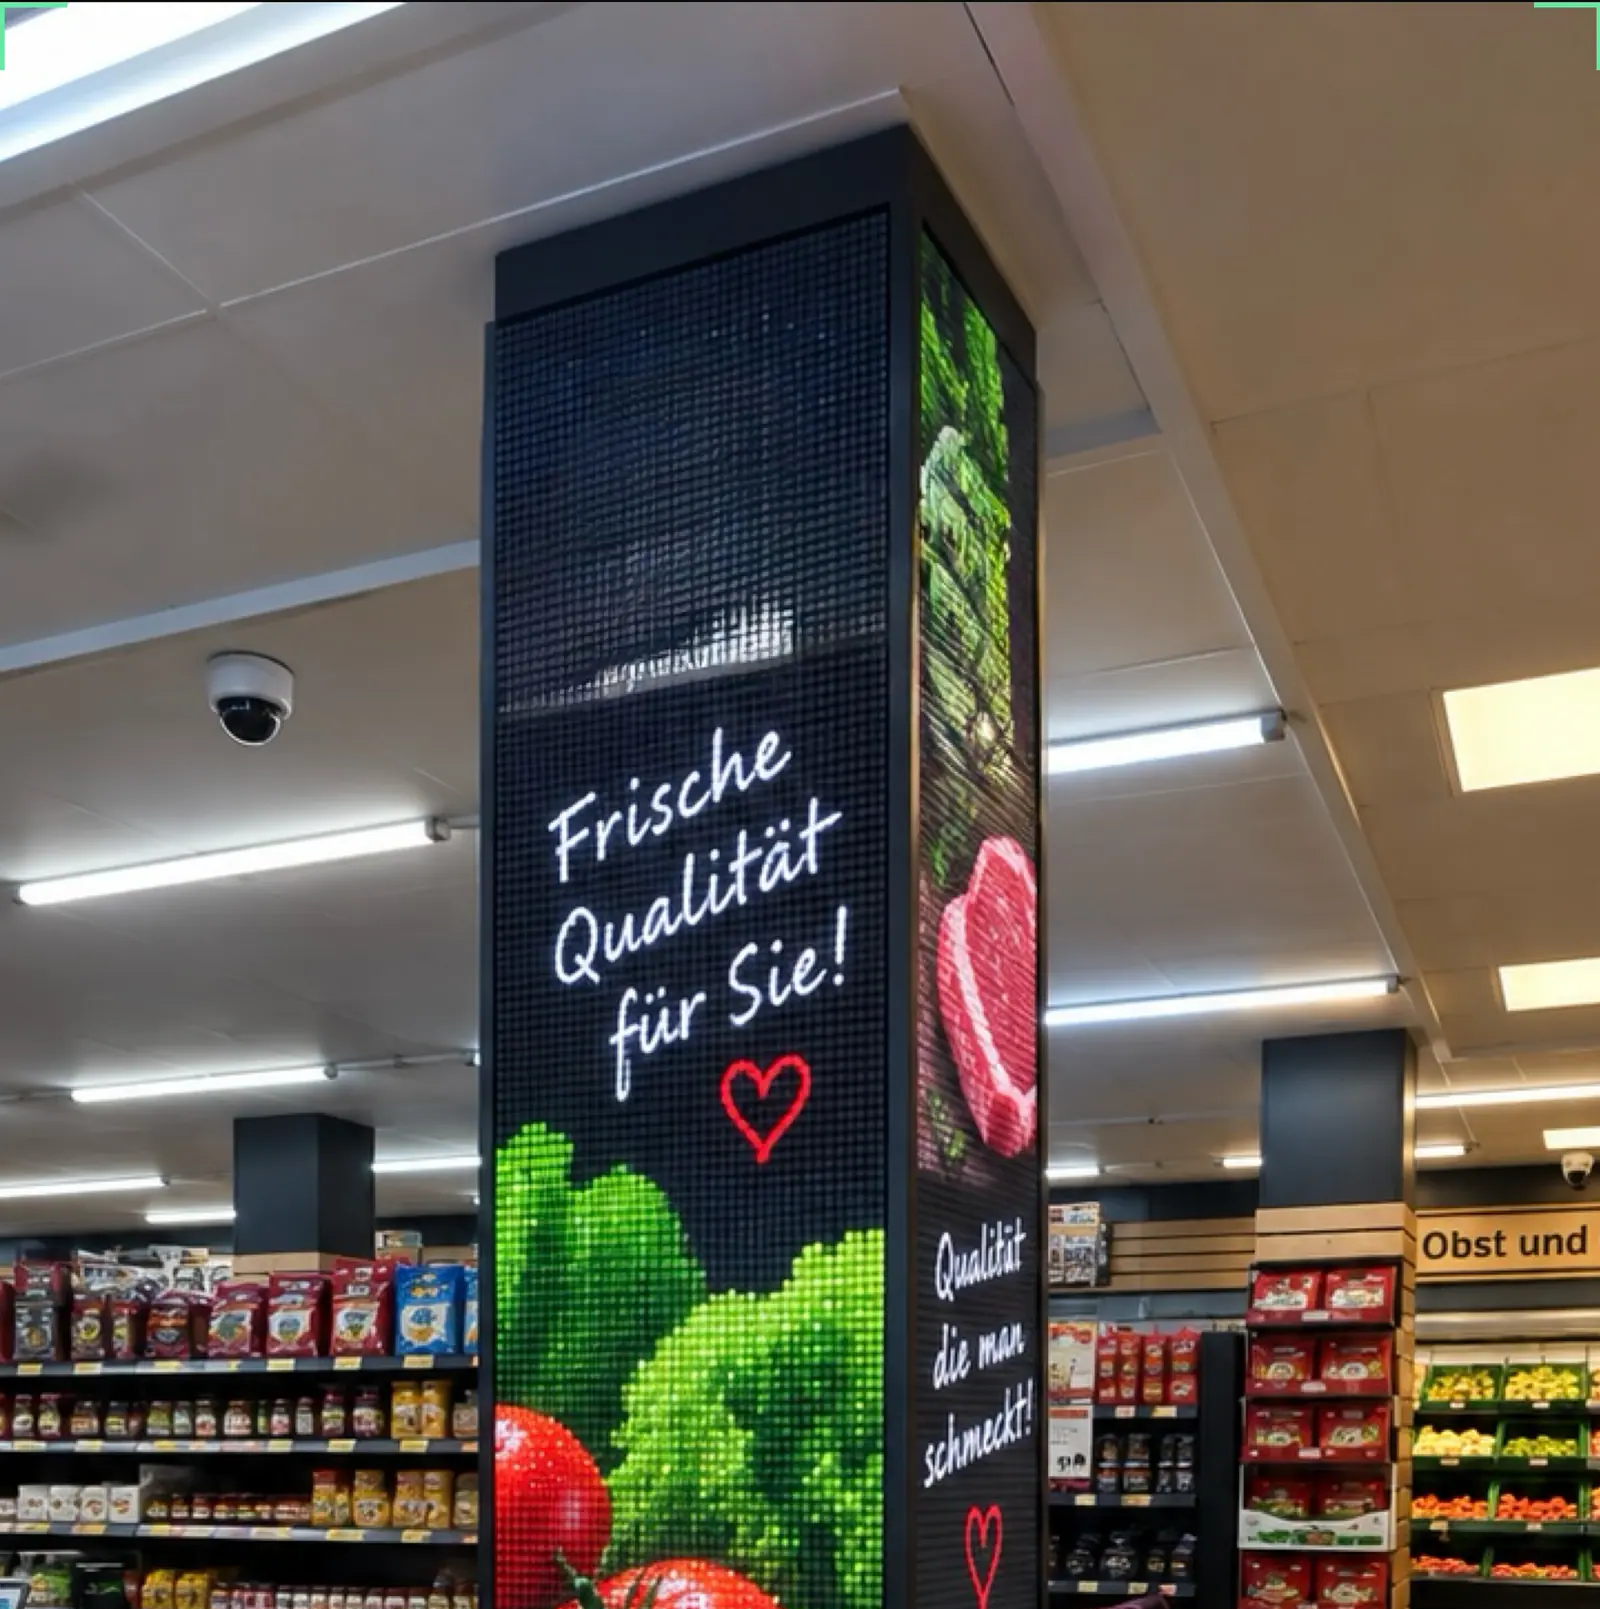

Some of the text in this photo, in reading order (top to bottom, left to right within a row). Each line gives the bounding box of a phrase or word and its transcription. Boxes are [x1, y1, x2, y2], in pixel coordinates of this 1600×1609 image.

[548, 727, 792, 883] Frische
[554, 797, 843, 984] Qualität
[609, 905, 848, 1102] für Sie!
[935, 1217, 1027, 1302] Qualität
[1422, 1223, 1588, 1260] Obst und
[933, 1323, 971, 1390] die
[978, 1323, 1024, 1370] man
[923, 1378, 1034, 1488] schmeckt!
